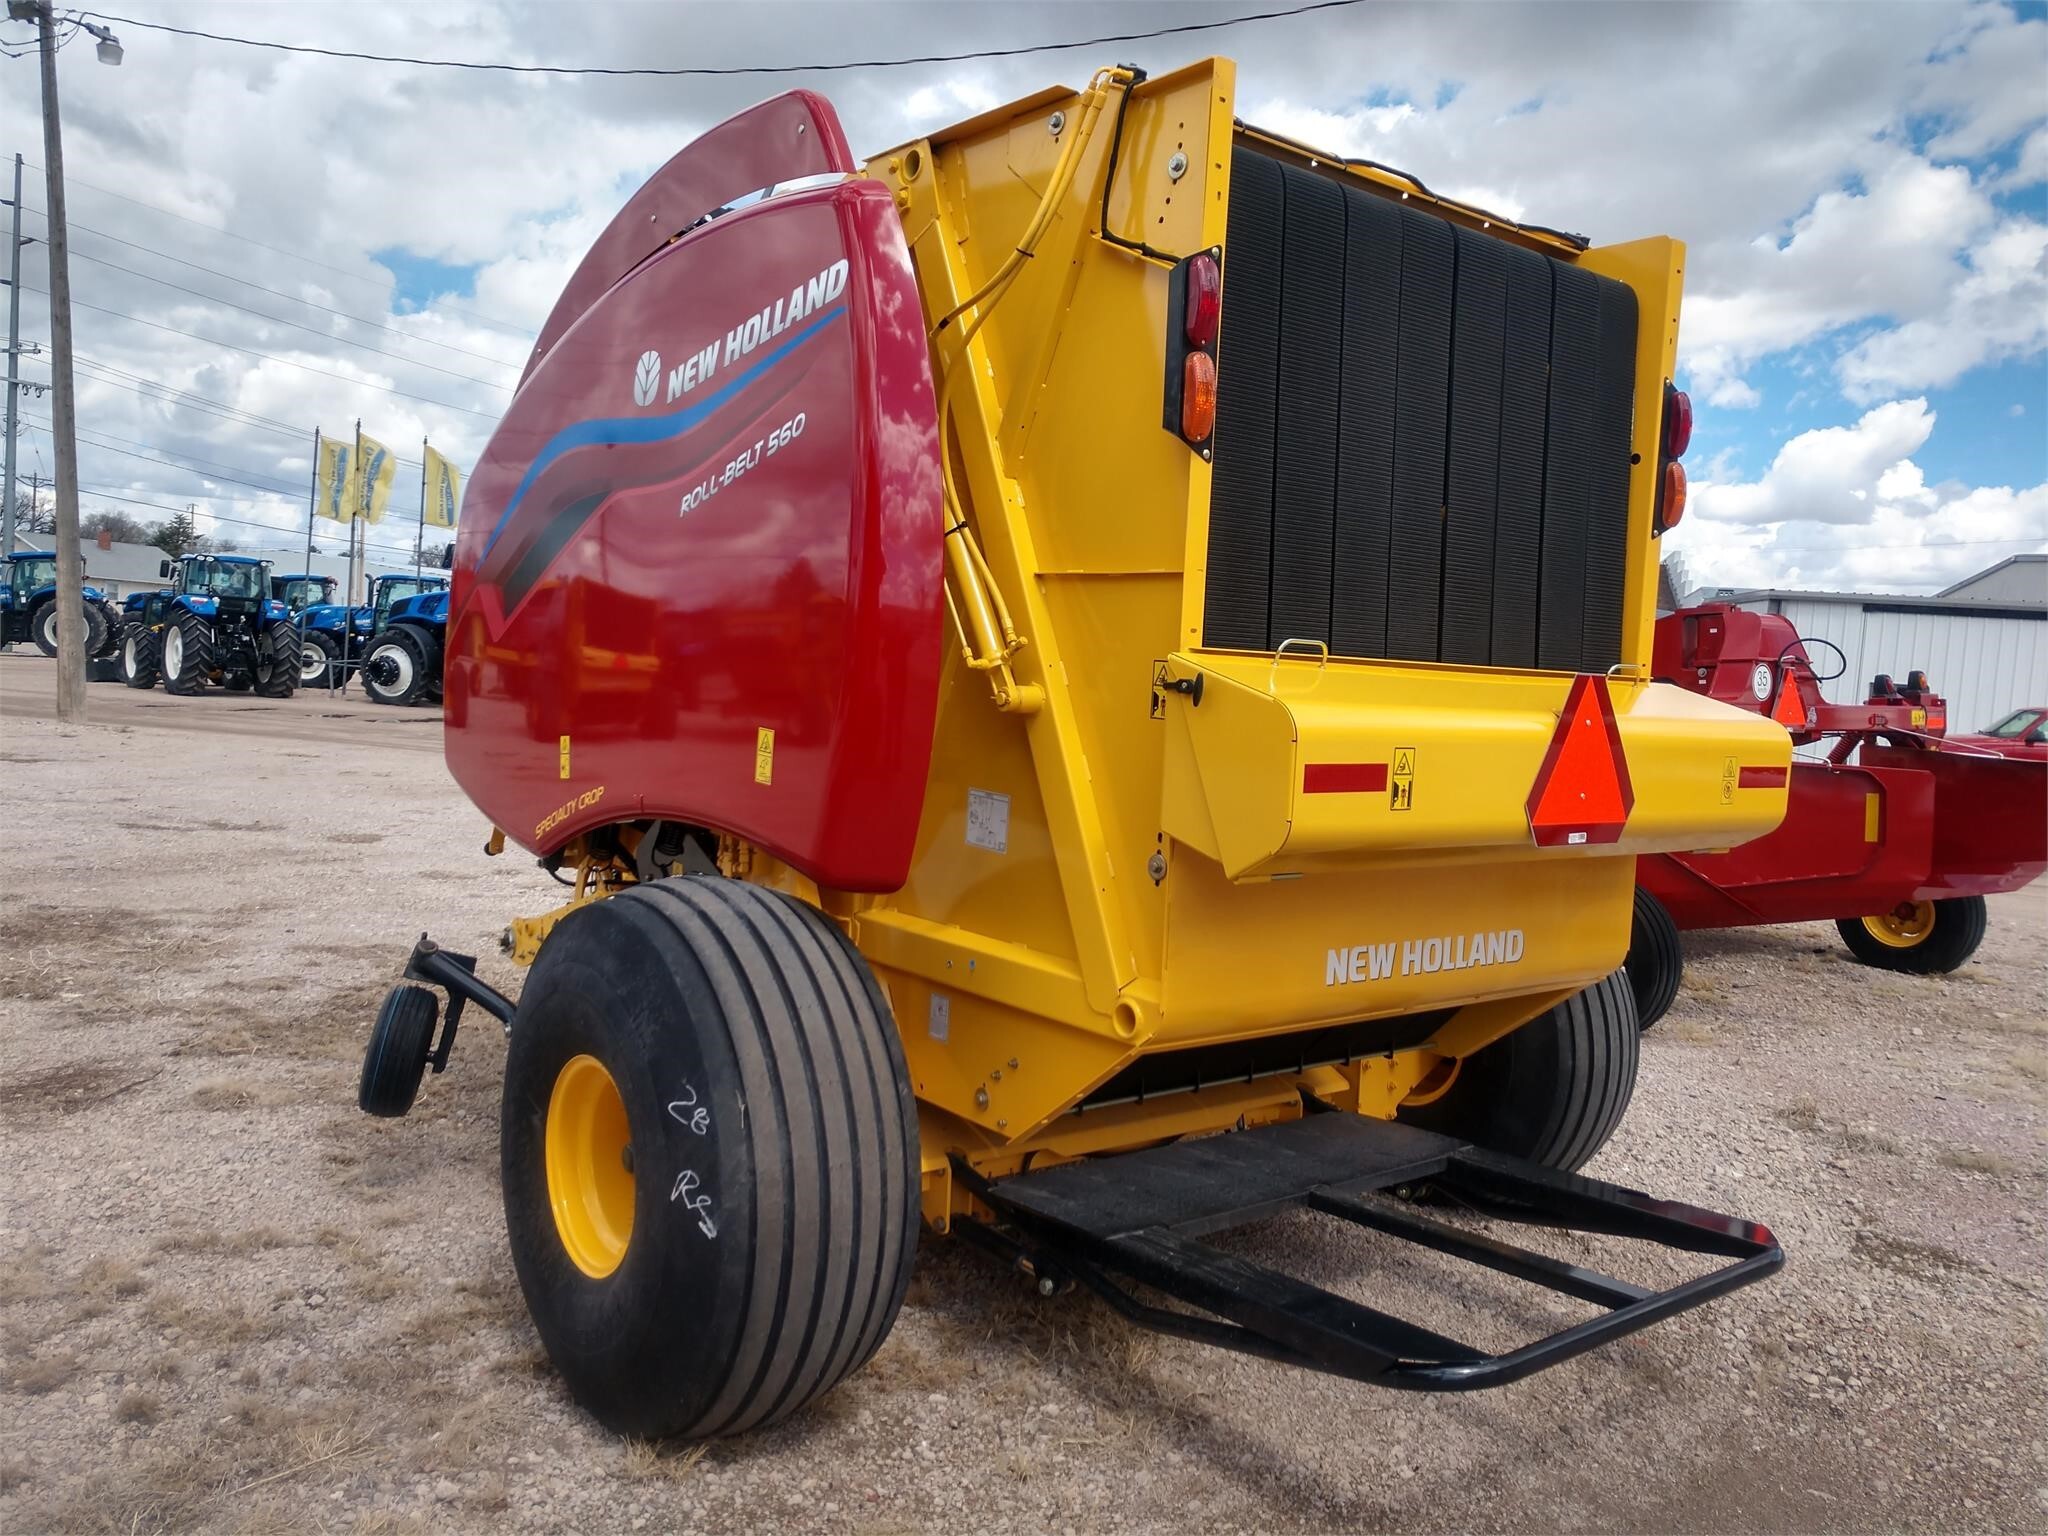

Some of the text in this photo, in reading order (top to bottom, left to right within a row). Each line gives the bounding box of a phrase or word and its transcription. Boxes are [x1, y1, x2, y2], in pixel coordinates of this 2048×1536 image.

[666, 258, 849, 404] NEW HOLLAND
[680, 412, 806, 518] ROLL-BELT 560
[1757, 671, 1768, 687] 35
[535, 786, 605, 841] SPECIALTY CROP
[1326, 929, 1524, 986] NEW HOLLAND
